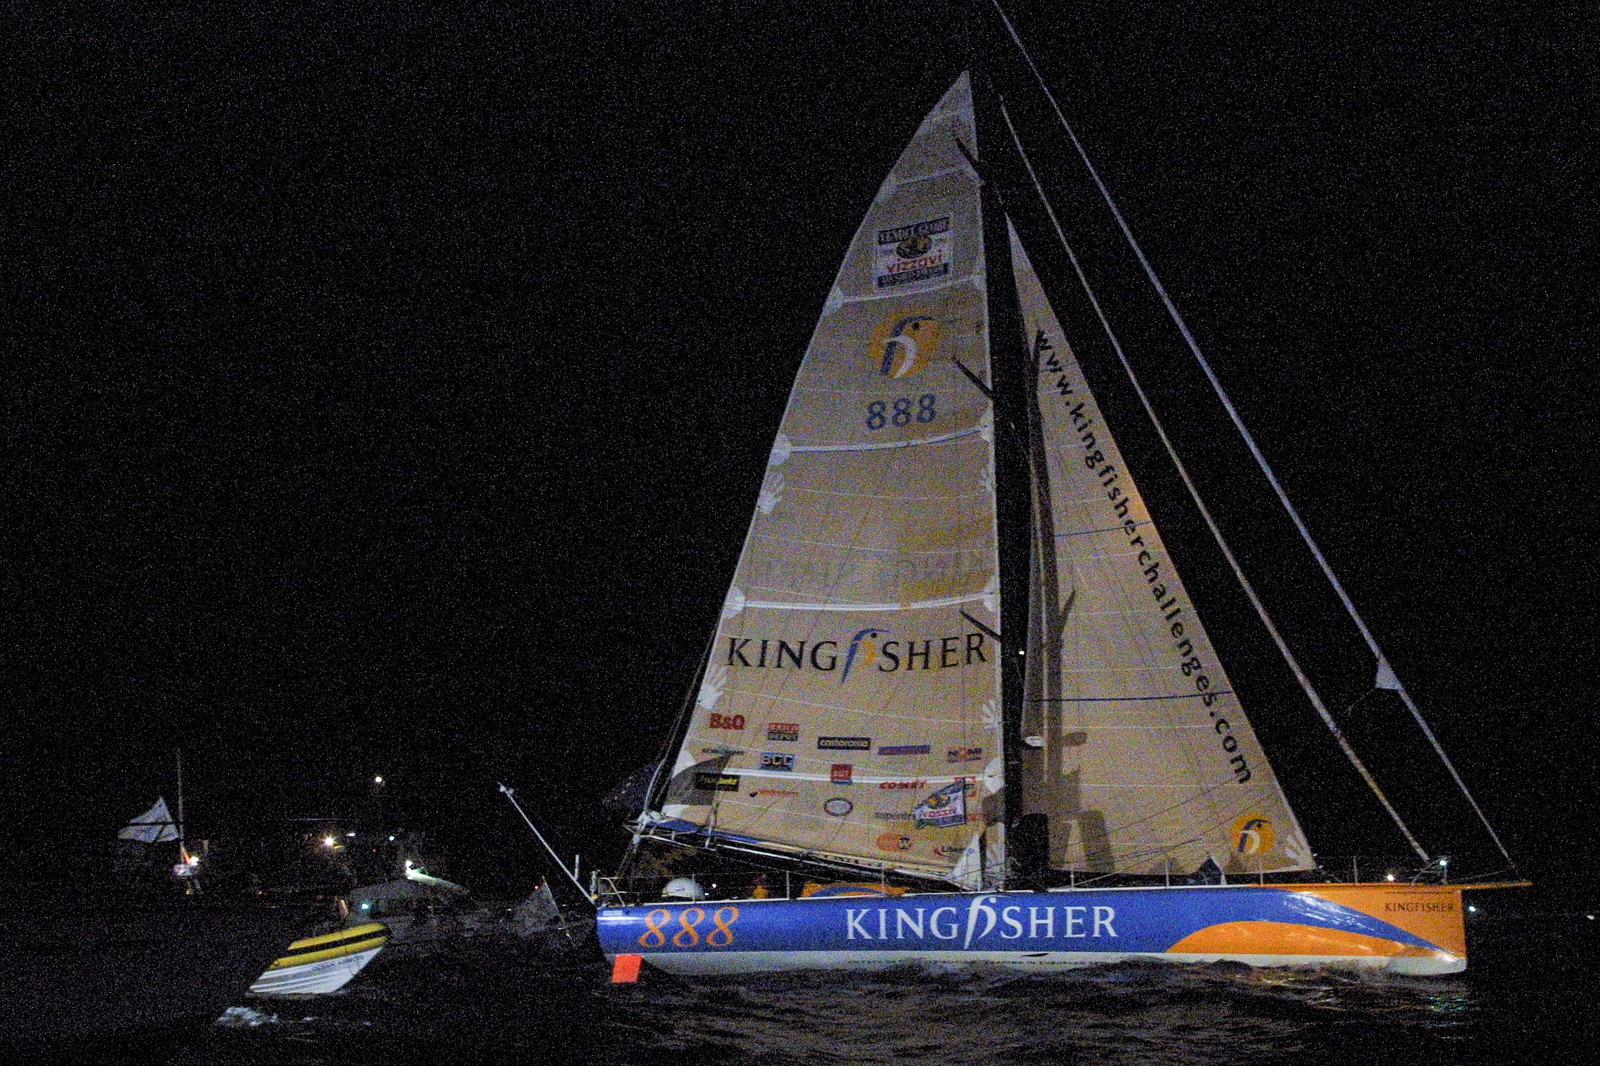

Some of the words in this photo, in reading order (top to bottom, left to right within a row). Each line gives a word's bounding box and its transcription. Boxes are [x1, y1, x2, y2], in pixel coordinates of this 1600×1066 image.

[866, 393, 936, 431] 888
[1034, 329, 1253, 784] www.kingfisherchallenges.com
[820, 739, 868, 748] castorama
[879, 781, 927, 790] COMET
[1385, 902, 1454, 912] KINGFISHER
[638, 906, 740, 949] 888
